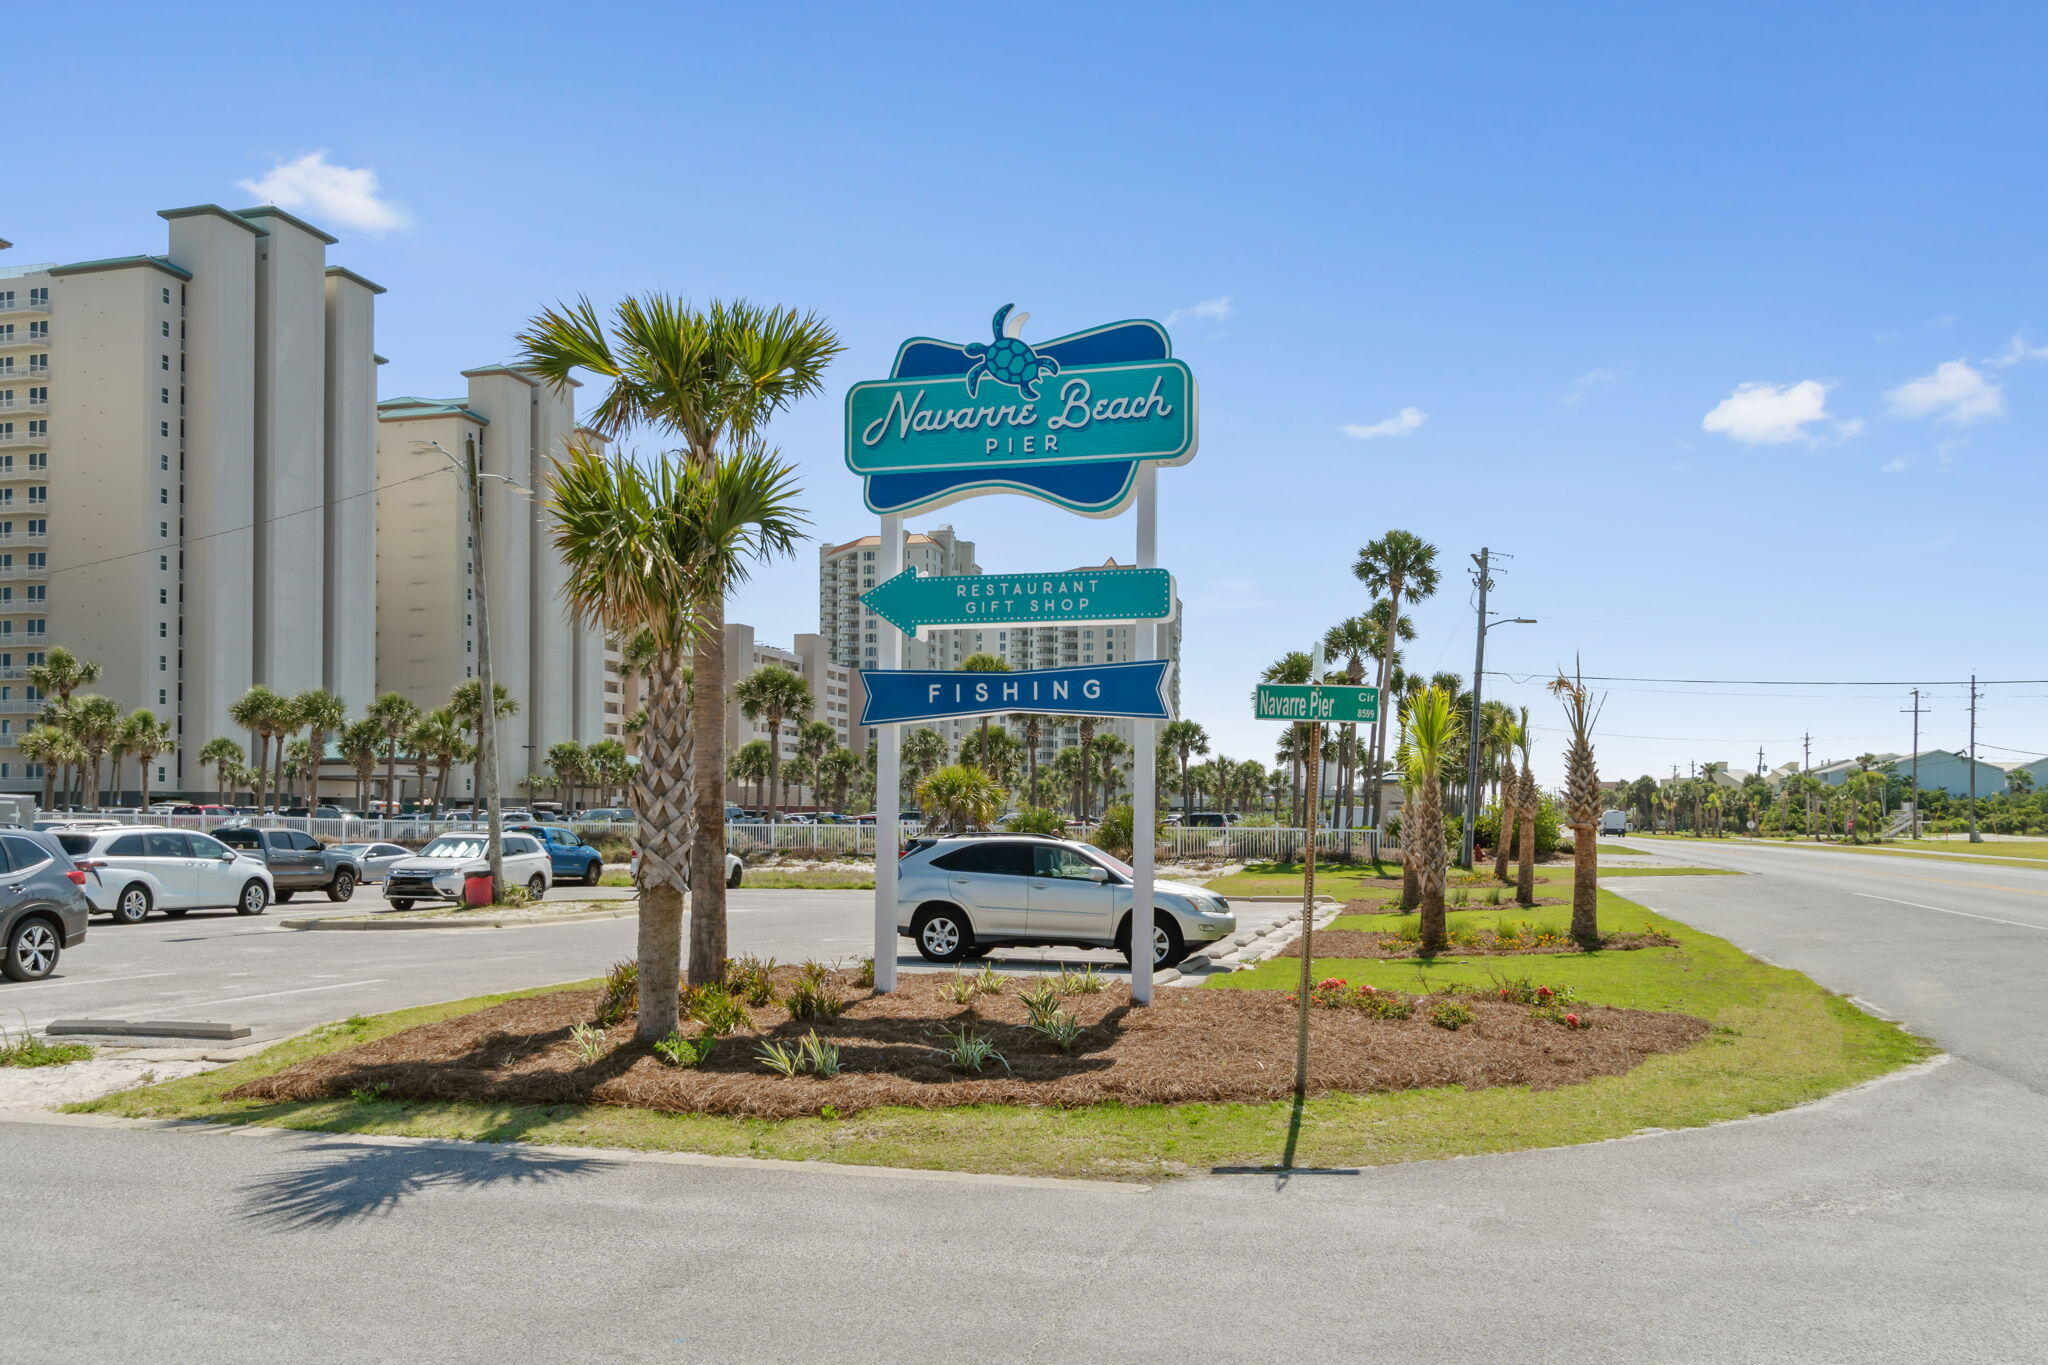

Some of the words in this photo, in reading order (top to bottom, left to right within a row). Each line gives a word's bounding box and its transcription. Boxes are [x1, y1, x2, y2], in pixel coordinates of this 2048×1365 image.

[862, 390, 1039, 446] Navarre
[1047, 375, 1173, 430] Beach
[986, 434, 1059, 455] PIER
[957, 580, 1098, 597] RESTAURANT
[965, 600, 1014, 614] GIFT
[1030, 598, 1090, 612] SHOP
[929, 679, 1101, 703] FISHING
[1260, 690, 1306, 716] Navarre
[1310, 690, 1335, 717] Pier
[1358, 692, 1376, 702] Cir
[1357, 708, 1375, 719] 8599
